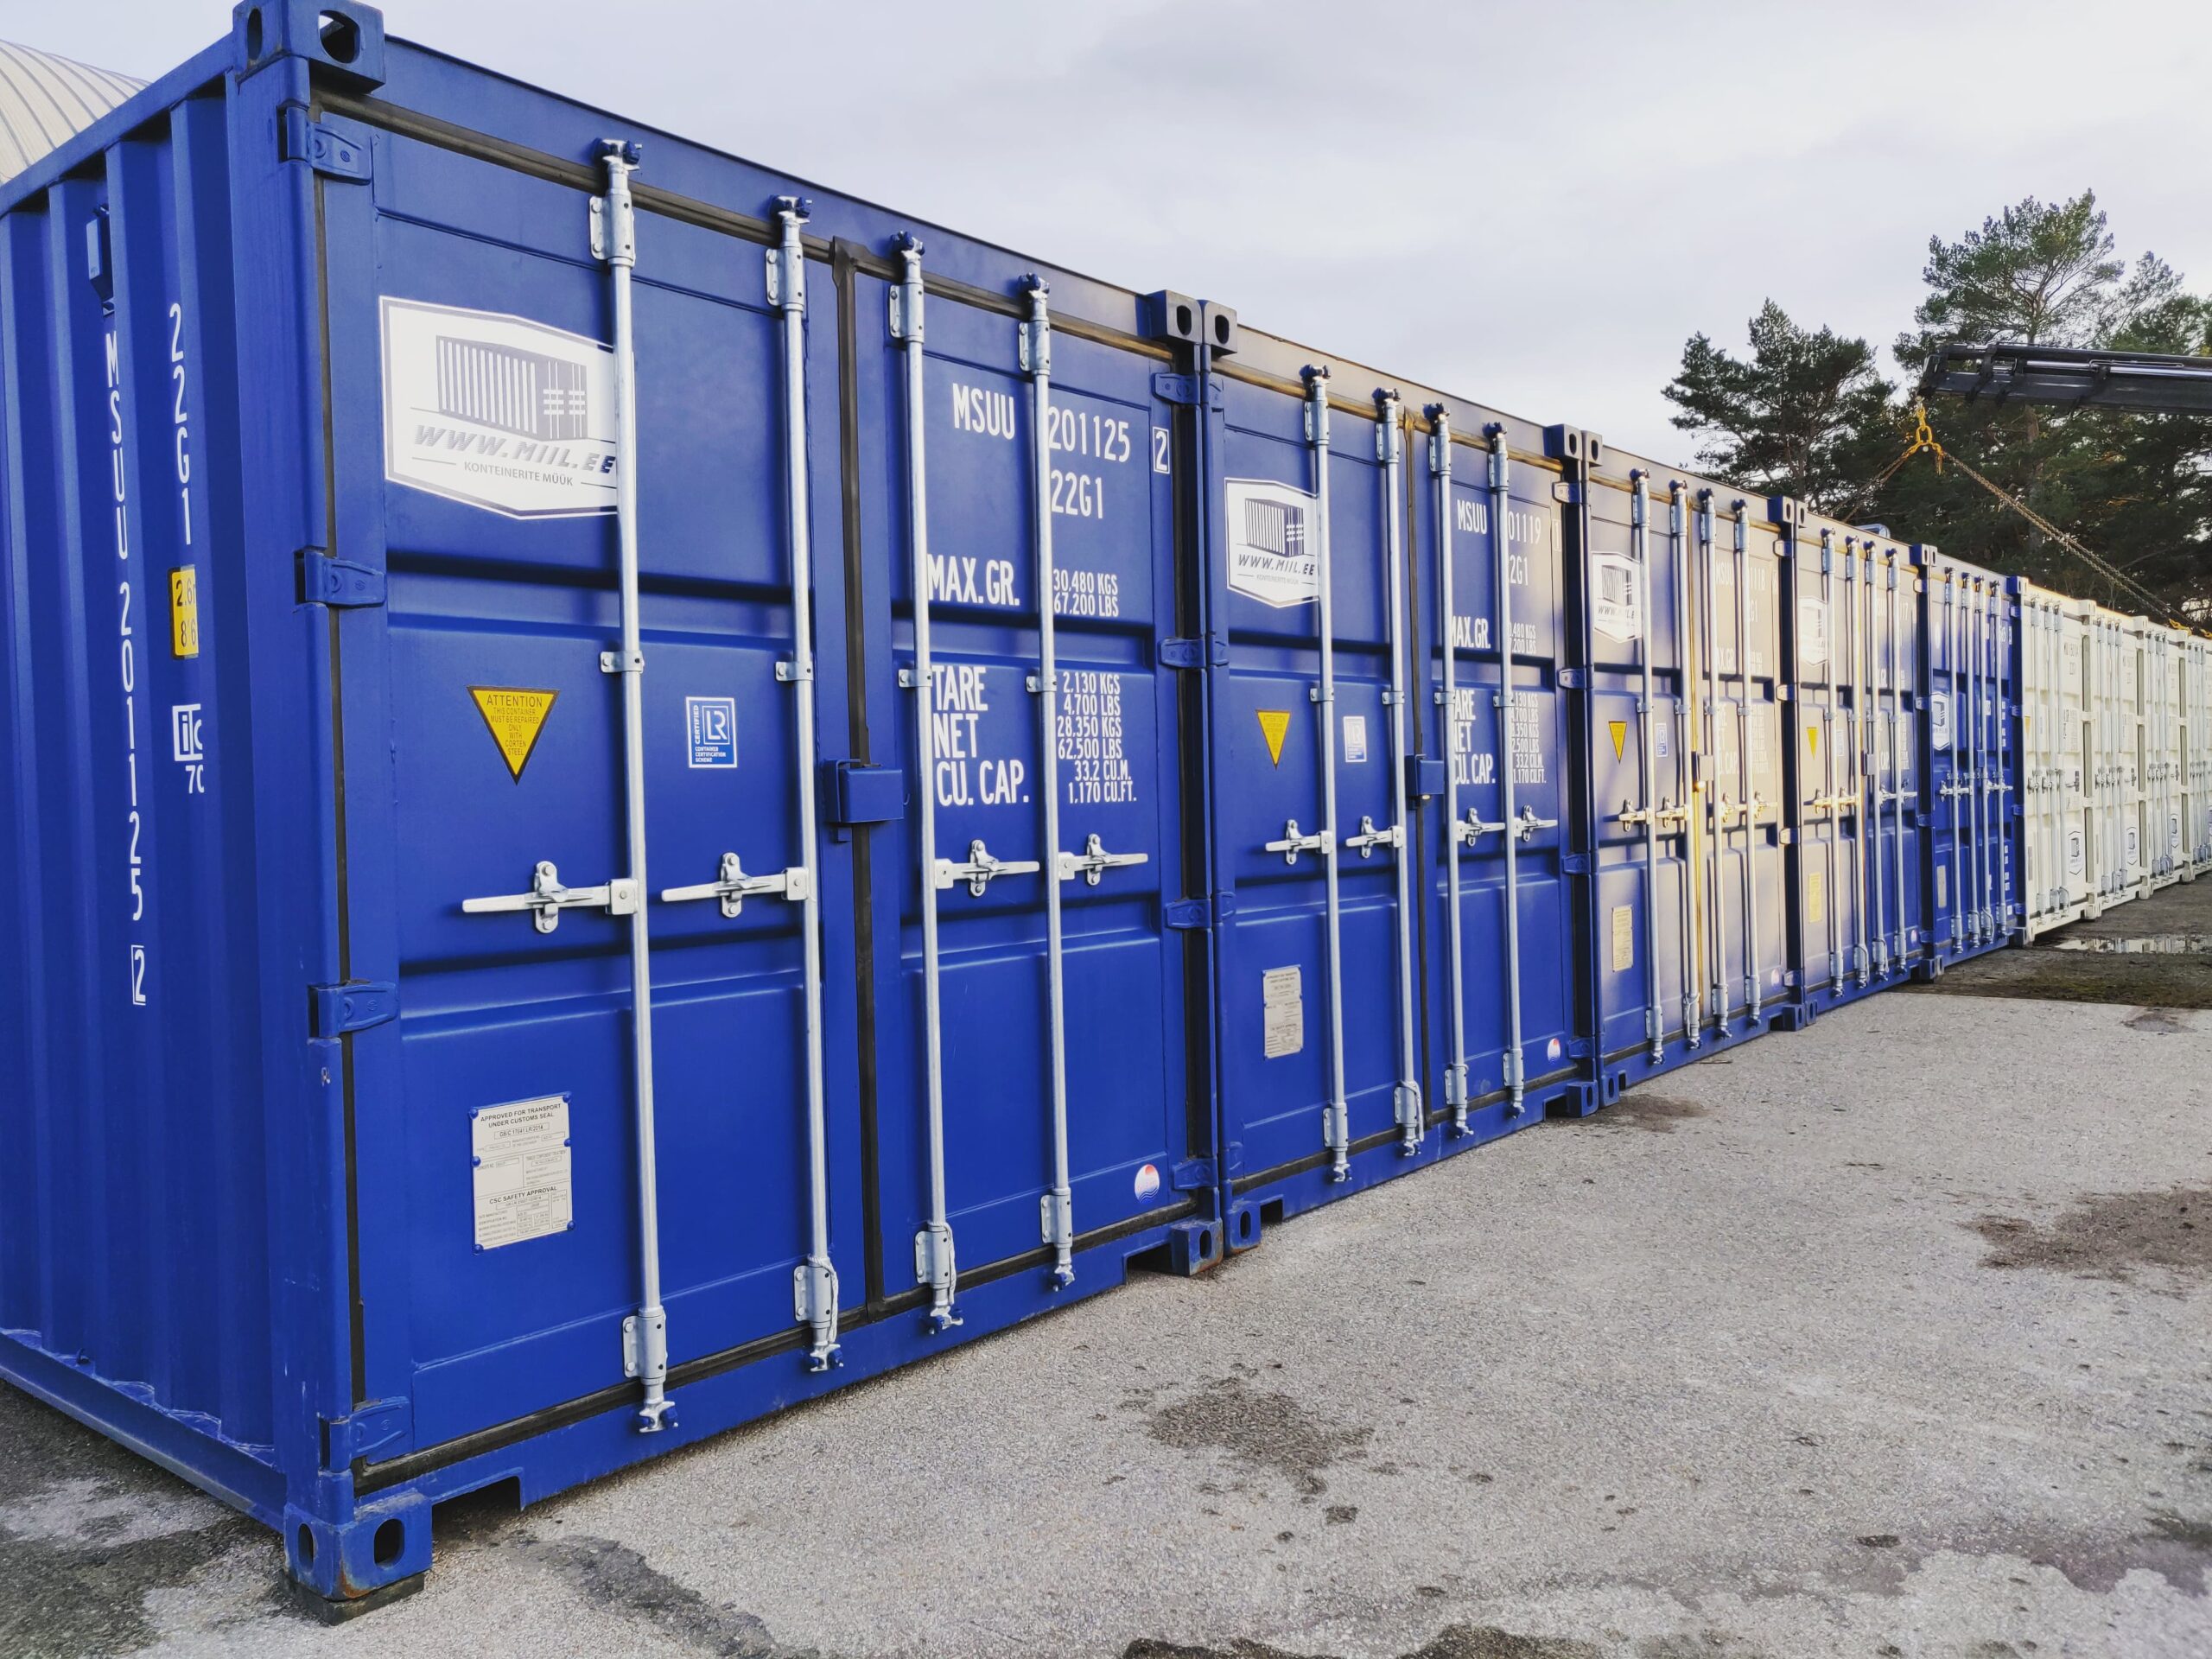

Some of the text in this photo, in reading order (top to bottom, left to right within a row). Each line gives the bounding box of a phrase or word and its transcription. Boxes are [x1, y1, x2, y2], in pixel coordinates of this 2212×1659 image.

[169, 302, 192, 545] 22G1
[952, 382, 1168, 471] MSUU 201125 2
[414, 424, 617, 474] WWW.MIIL.EE
[463, 461, 574, 486] KONTEINERITE MÜÜK
[1050, 469, 1103, 519] 22G1
[1457, 499, 1487, 535] MSUU
[1508, 511, 1541, 545] 01119
[1510, 554, 1529, 586] 2G1
[1097, 573, 1118, 596] KGS
[1098, 594, 1119, 618] LBS
[105, 330, 129, 561] MSUU
[118, 582, 144, 922] 201125
[1525, 624, 1536, 639] KGS
[1526, 639, 1536, 655] LBS
[931, 664, 988, 711] TARE
[1100, 673, 1121, 695] KGS
[486, 695, 543, 708] ATTENTION
[506, 708, 536, 716] CONTAINER
[1101, 695, 1122, 716] LBS
[1455, 690, 1476, 721] ARE
[513, 715, 540, 724] REPAIRED
[1102, 716, 1122, 738] KGS
[933, 713, 979, 759] NET
[1103, 738, 1122, 760] LBS
[1074, 760, 1100, 782] 33.2
[1471, 753, 1496, 784] CAP.
[936, 760, 1029, 807] CU. CAP.
[480, 1111, 513, 1122] APPROVED
[527, 1103, 561, 1114] TRANSPORT
[488, 1118, 510, 1128] UNDER
[510, 1115, 538, 1124] CUSTOMS
[503, 1192, 525, 1201] SAFETY
[526, 1185, 557, 1196] APPROVAL
